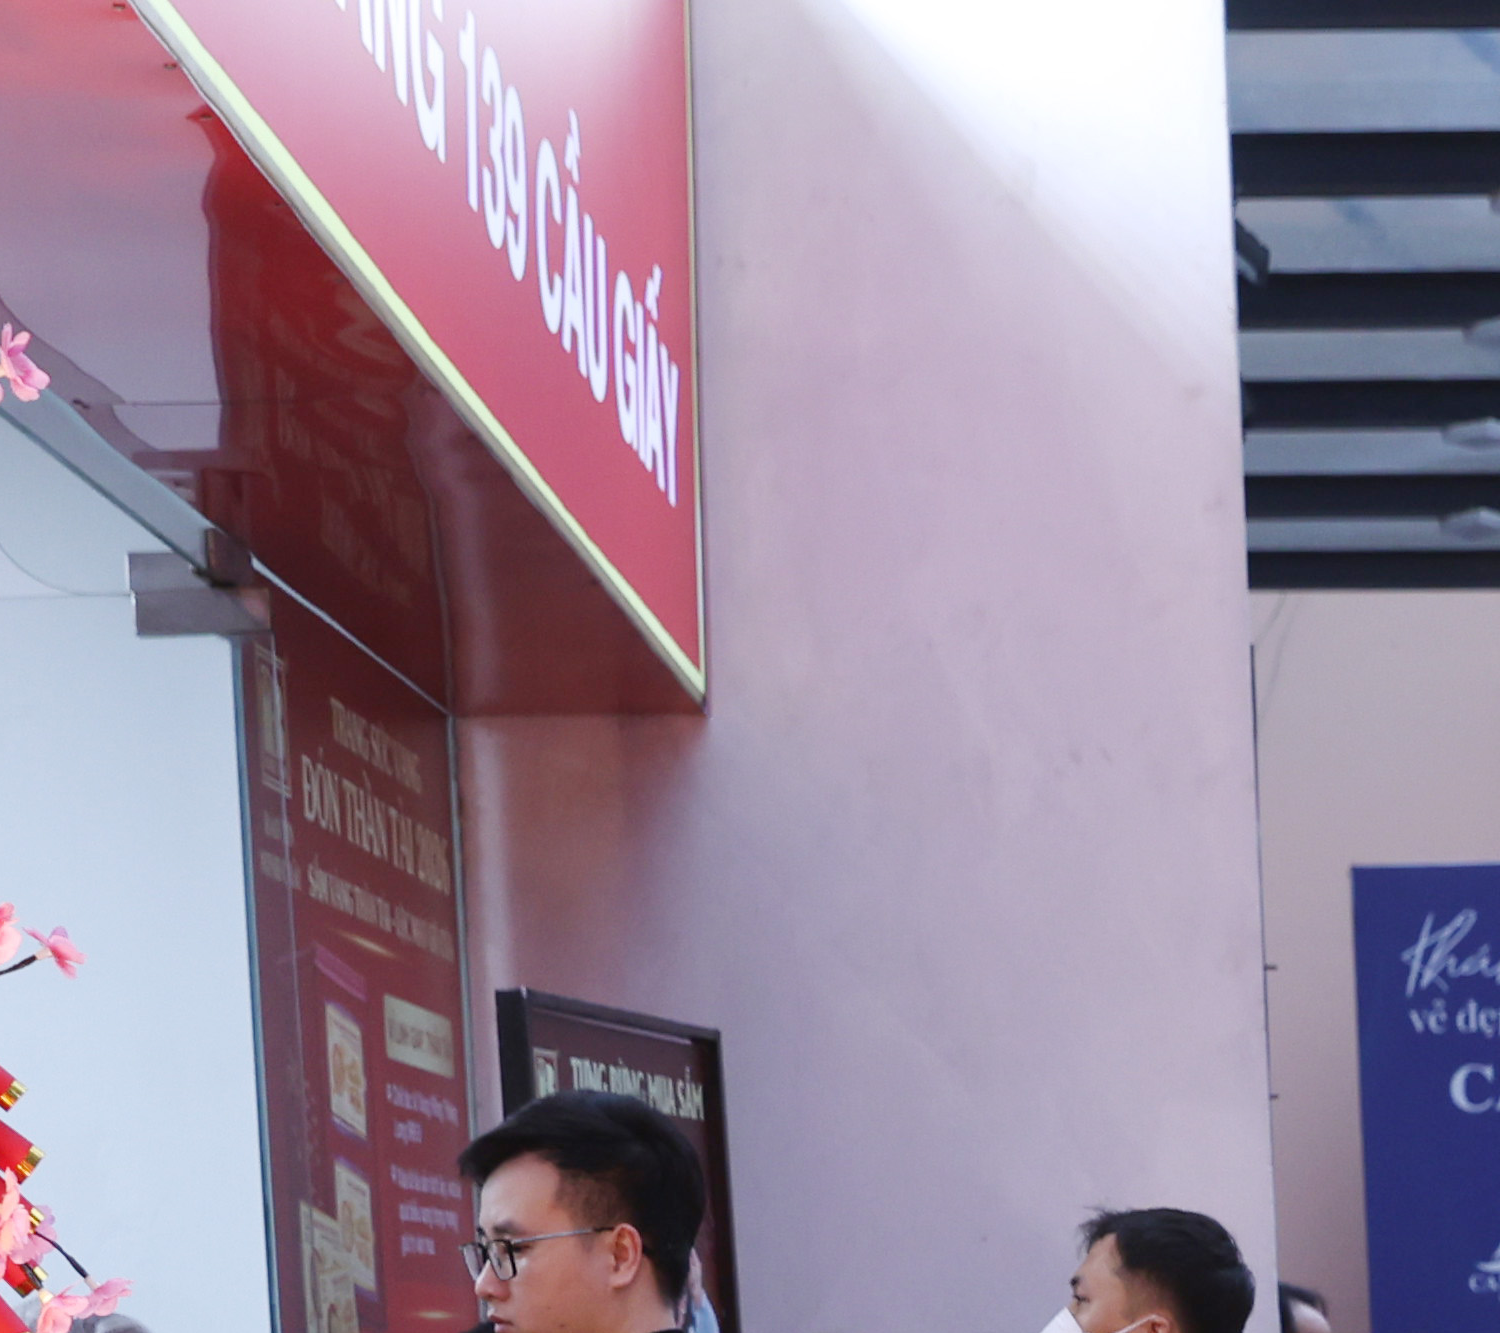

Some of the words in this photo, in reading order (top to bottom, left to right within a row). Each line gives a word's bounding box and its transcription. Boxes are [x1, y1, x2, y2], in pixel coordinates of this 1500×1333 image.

[459, 12, 527, 281] 139
[536, 108, 607, 402] CẦU
[613, 264, 679, 507] GIẤY
[301, 746, 341, 836] ĐÓN
